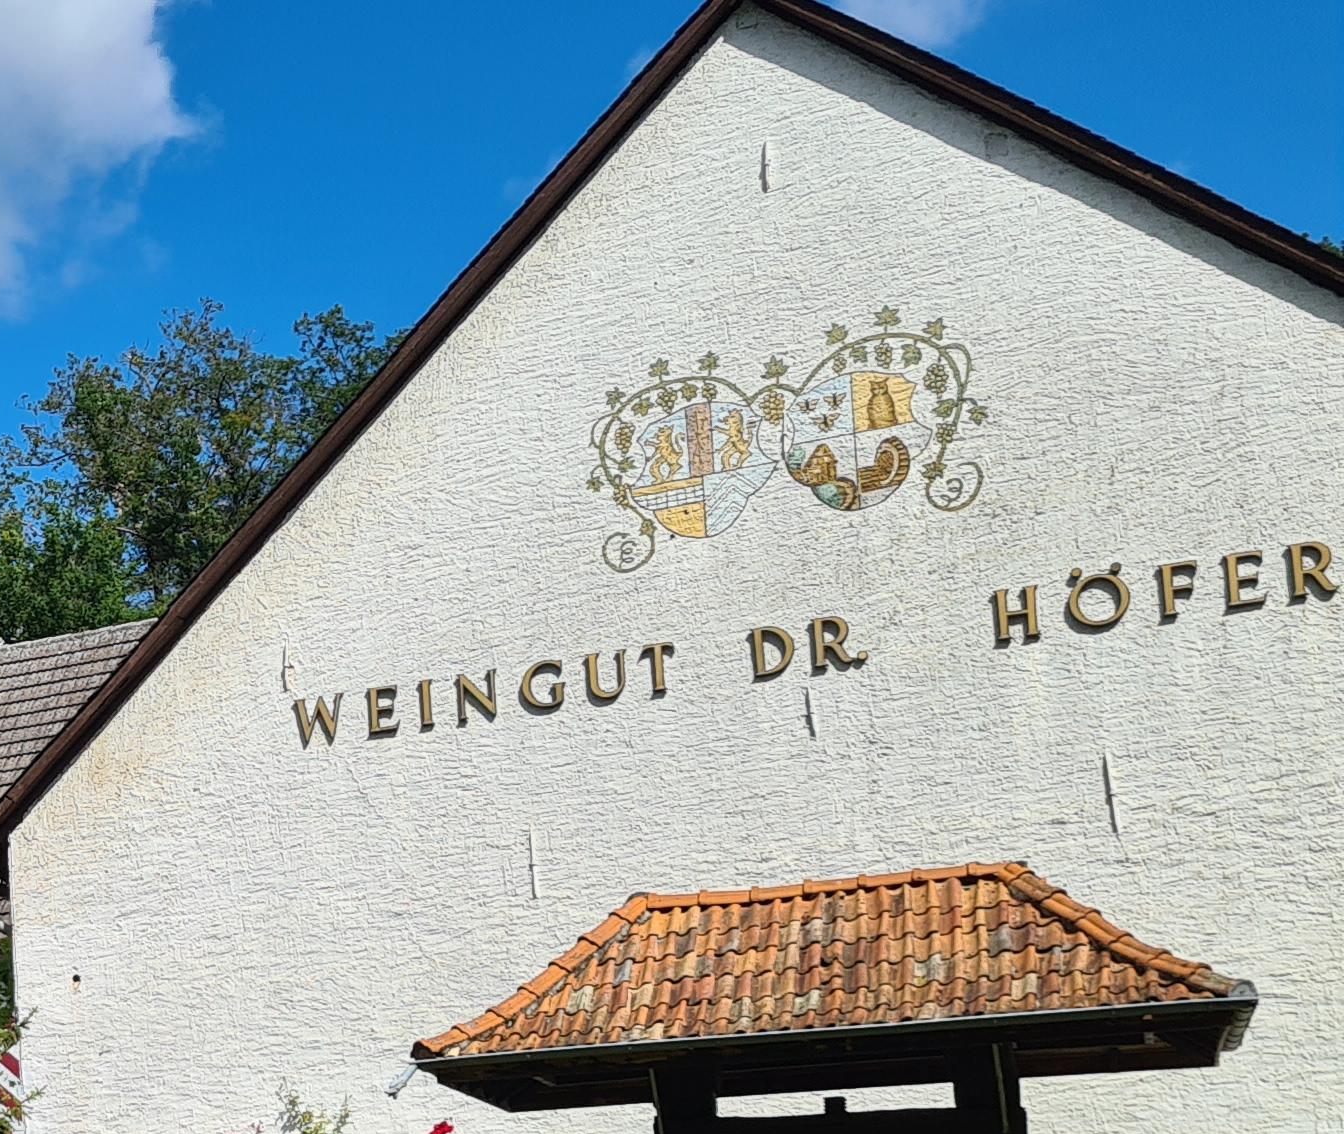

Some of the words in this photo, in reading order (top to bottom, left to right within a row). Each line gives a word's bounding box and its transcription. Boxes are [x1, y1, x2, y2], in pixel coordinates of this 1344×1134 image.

[294, 641, 675, 749] WEINGUT
[750, 614, 869, 682] DR.
[992, 540, 1340, 645] HÖFER
